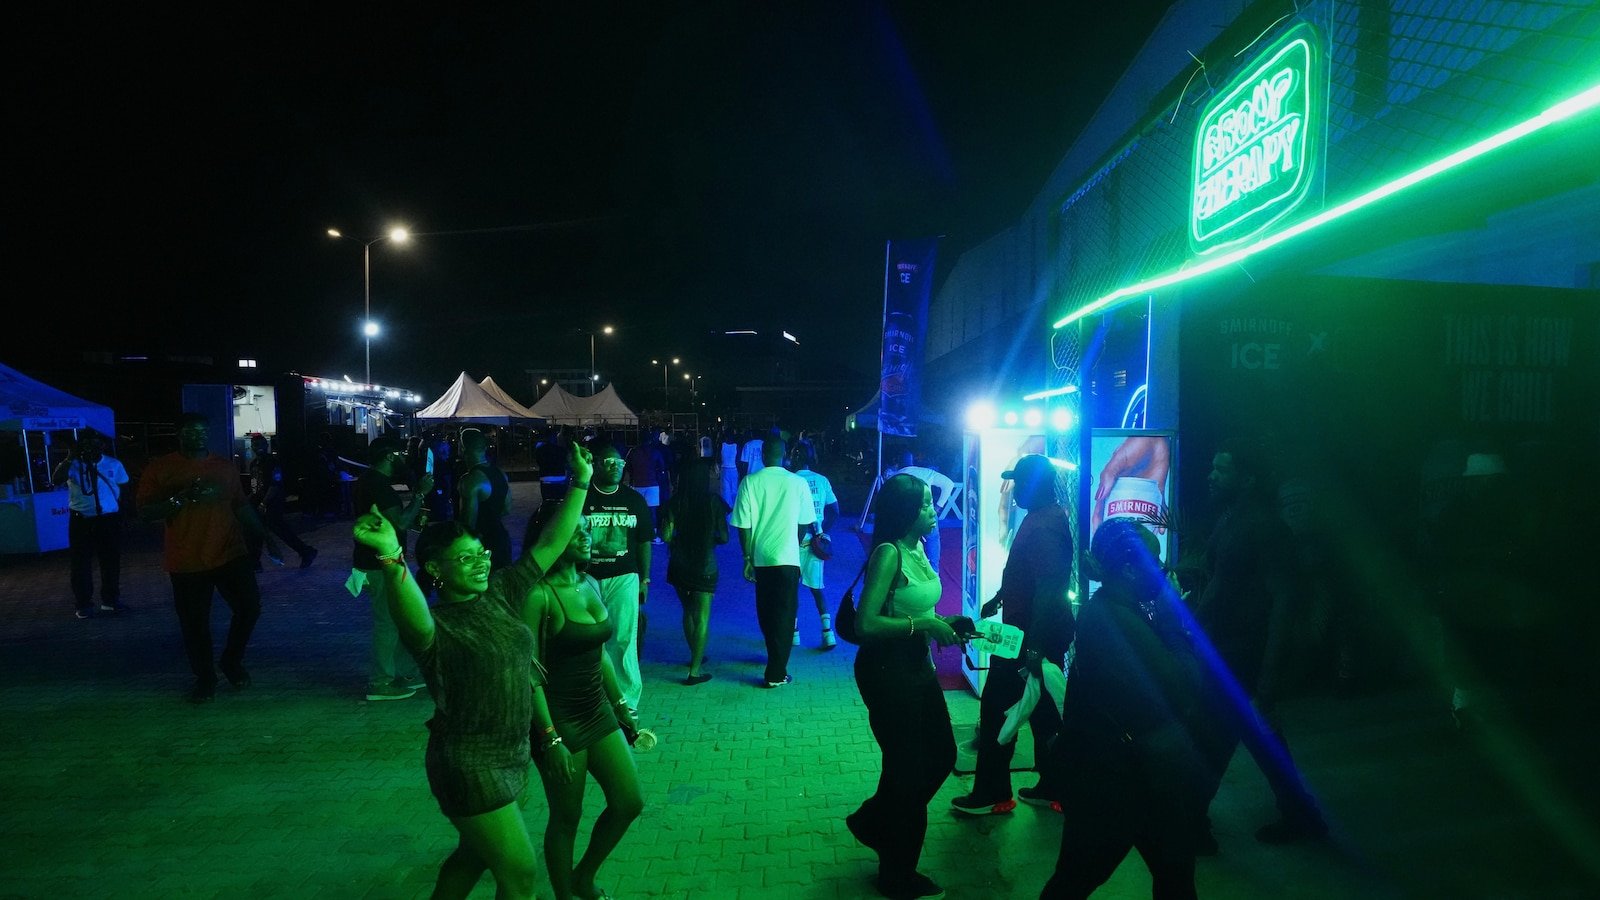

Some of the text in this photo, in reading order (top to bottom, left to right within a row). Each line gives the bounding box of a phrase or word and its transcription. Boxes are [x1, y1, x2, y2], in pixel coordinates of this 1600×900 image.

[1197, 118, 1299, 219] THERAPY
[1219, 318, 1294, 336] SMIRNOFF
[889, 343, 905, 354] ICE
[1231, 342, 1281, 370] ICE
